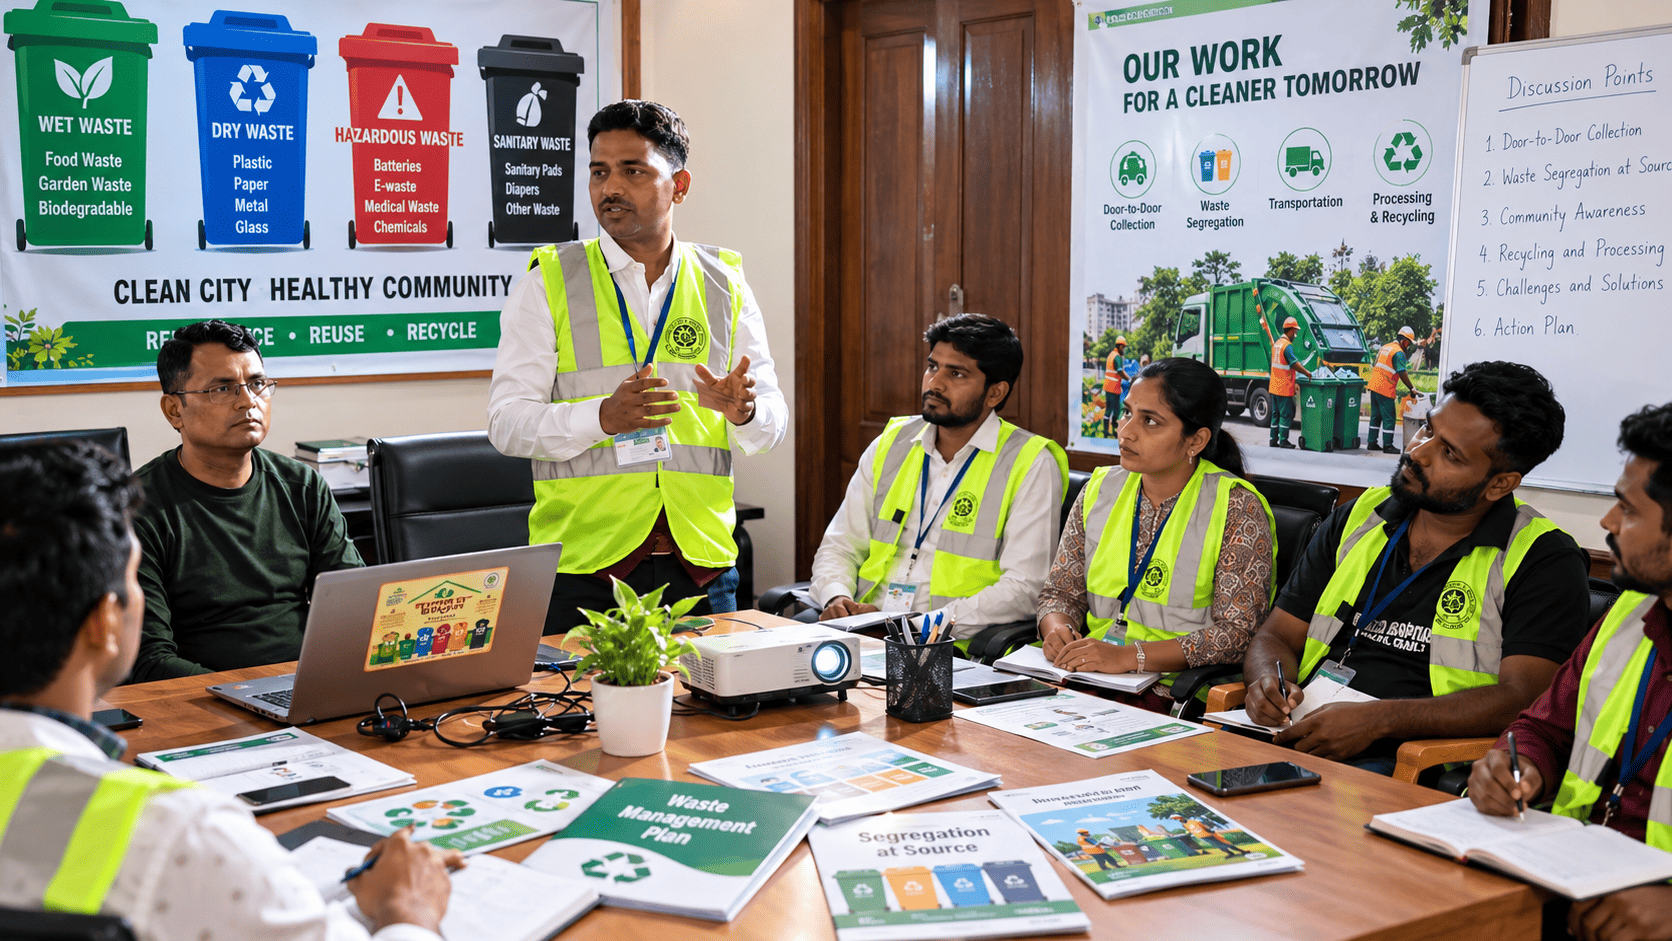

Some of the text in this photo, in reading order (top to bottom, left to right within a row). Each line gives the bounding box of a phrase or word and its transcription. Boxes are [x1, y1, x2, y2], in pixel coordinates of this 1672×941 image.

[1123, 34, 1283, 84] OUR WORK
[1123, 61, 1421, 114] FOR A CLEANER TOMORROW
[1507, 61, 1653, 99] Discussion Points
[38, 115, 133, 135] WET WASTE
[212, 122, 294, 140] DRY WASTE
[335, 127, 464, 147] HAZARDOUS WASTE
[493, 134, 571, 151] SANITARY WASTE
[1486, 121, 1642, 153] 1. Door-to-Door Collection
[45, 151, 122, 168] Food Waste
[233, 154, 272, 169] Plastic
[374, 158, 422, 172] Batteries
[505, 162, 563, 179] Sanitary Pads
[1483, 169, 1495, 186] 2.
[1502, 167, 1536, 185] Waste
[1544, 160, 1611, 190] Segregation
[1617, 158, 1632, 175] at
[38, 175, 132, 192] Garden Waste
[234, 176, 269, 194] Paper
[374, 179, 417, 193] E-waste
[505, 182, 540, 198] Diapers
[235, 198, 268, 212] Metal
[364, 200, 439, 213] Medical Waste
[1200, 200, 1230, 212] Waste
[1269, 195, 1343, 211] Transportation
[1373, 191, 1432, 206] Processing
[39, 200, 133, 219] Biodegradable
[506, 202, 560, 216] Other Waste
[1103, 202, 1162, 215] Door-to-Door
[1481, 201, 1646, 233] 3. Community Awareness
[1110, 219, 1155, 231] Collection
[1186, 216, 1244, 231] Segregation
[1370, 209, 1435, 226] & Recycling
[235, 219, 269, 234] Glass
[374, 220, 428, 233] Chemicals
[1479, 238, 1665, 271] 4. Recycling and Processing
[114, 275, 513, 304] CLEAN CITY HEALTHY COMMUNITY
[1477, 273, 1664, 305] 5. Challenges and Solutions
[1474, 318, 1486, 337] 6.
[1494, 317, 1534, 336] Action
[146, 322, 477, 350] RECE REUSE RECYCLE
[667, 793, 729, 813] Waste
[618, 805, 757, 835] Management
[640, 826, 692, 846] Plan
[858, 826, 991, 845] Segregation
[877, 843, 979, 858] at Source
